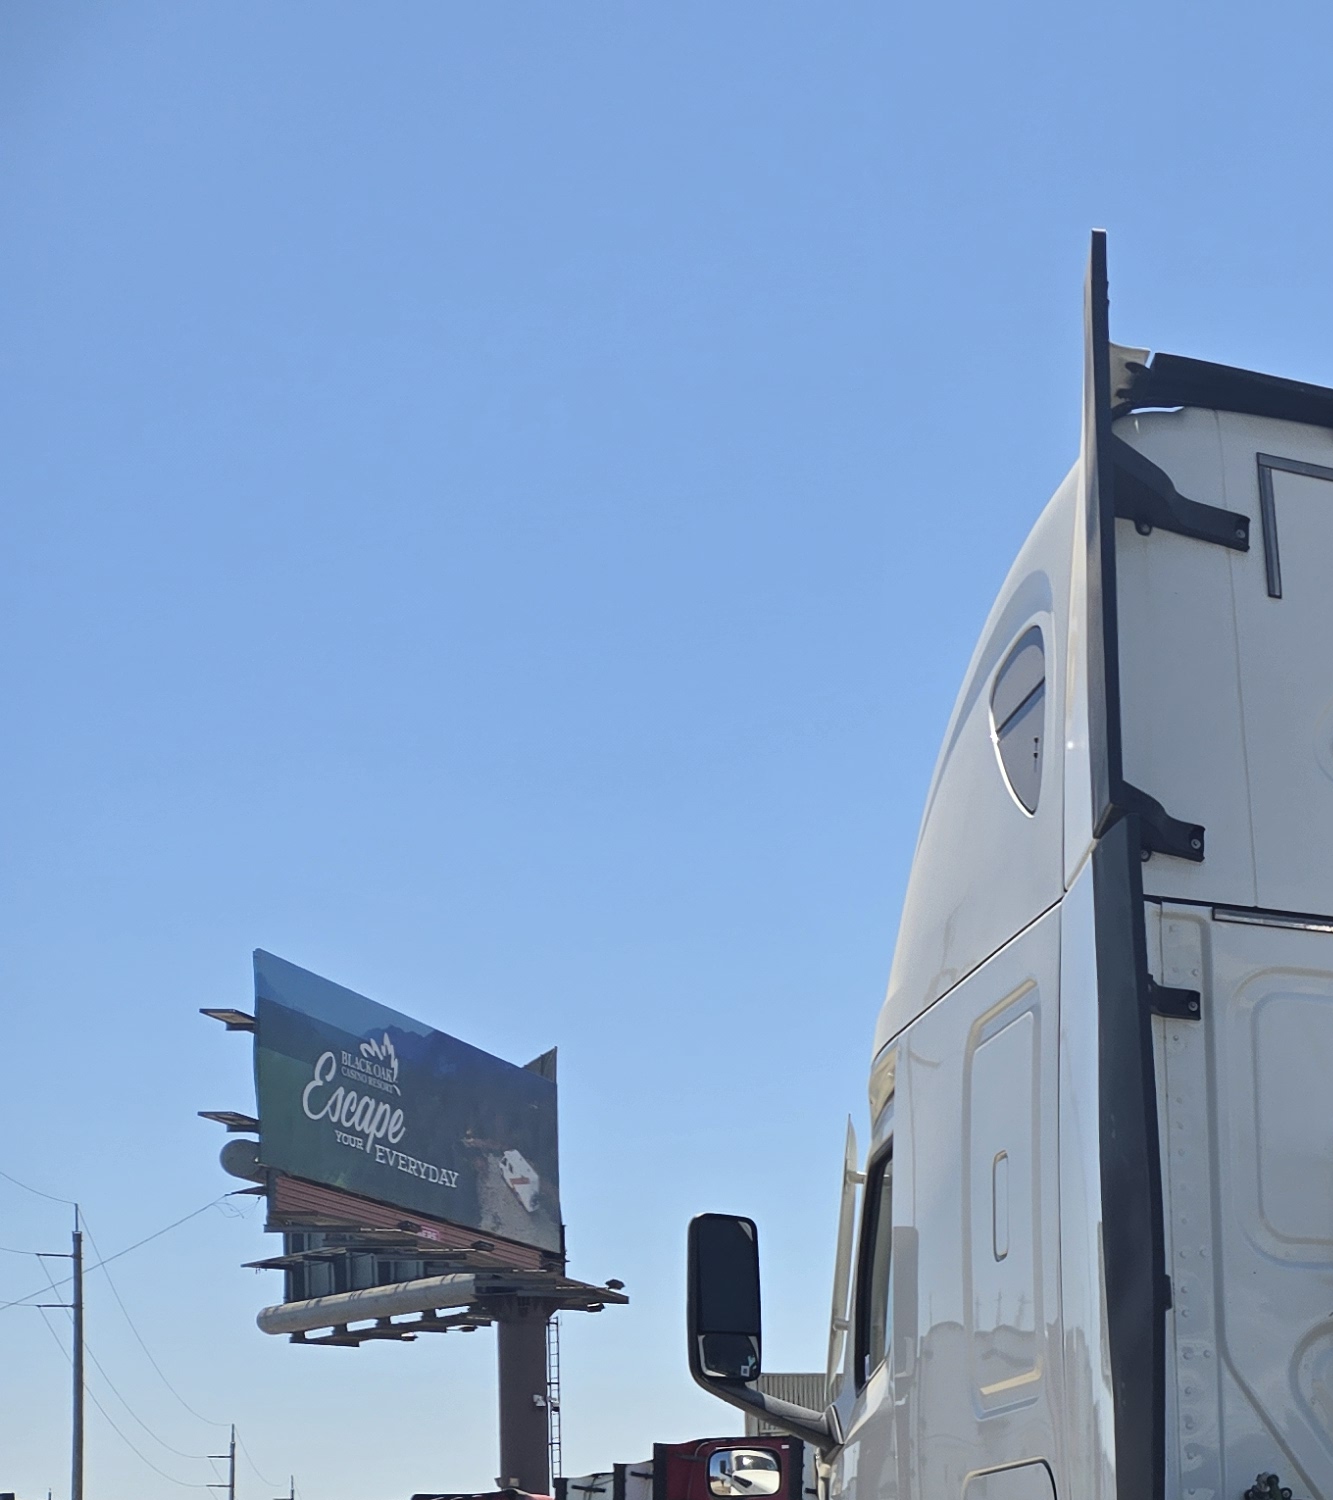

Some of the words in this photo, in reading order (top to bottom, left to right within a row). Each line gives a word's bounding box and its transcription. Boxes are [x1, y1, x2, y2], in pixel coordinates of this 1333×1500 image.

[341, 1050, 373, 1075] BLACK
[373, 1063, 394, 1083] OAK
[341, 1066, 368, 1083] CASINO
[368, 1077, 394, 1094] RESORT
[302, 1051, 406, 1154] Escape
[334, 1129, 365, 1151] YOUR
[374, 1144, 460, 1188] EVERYDAY
